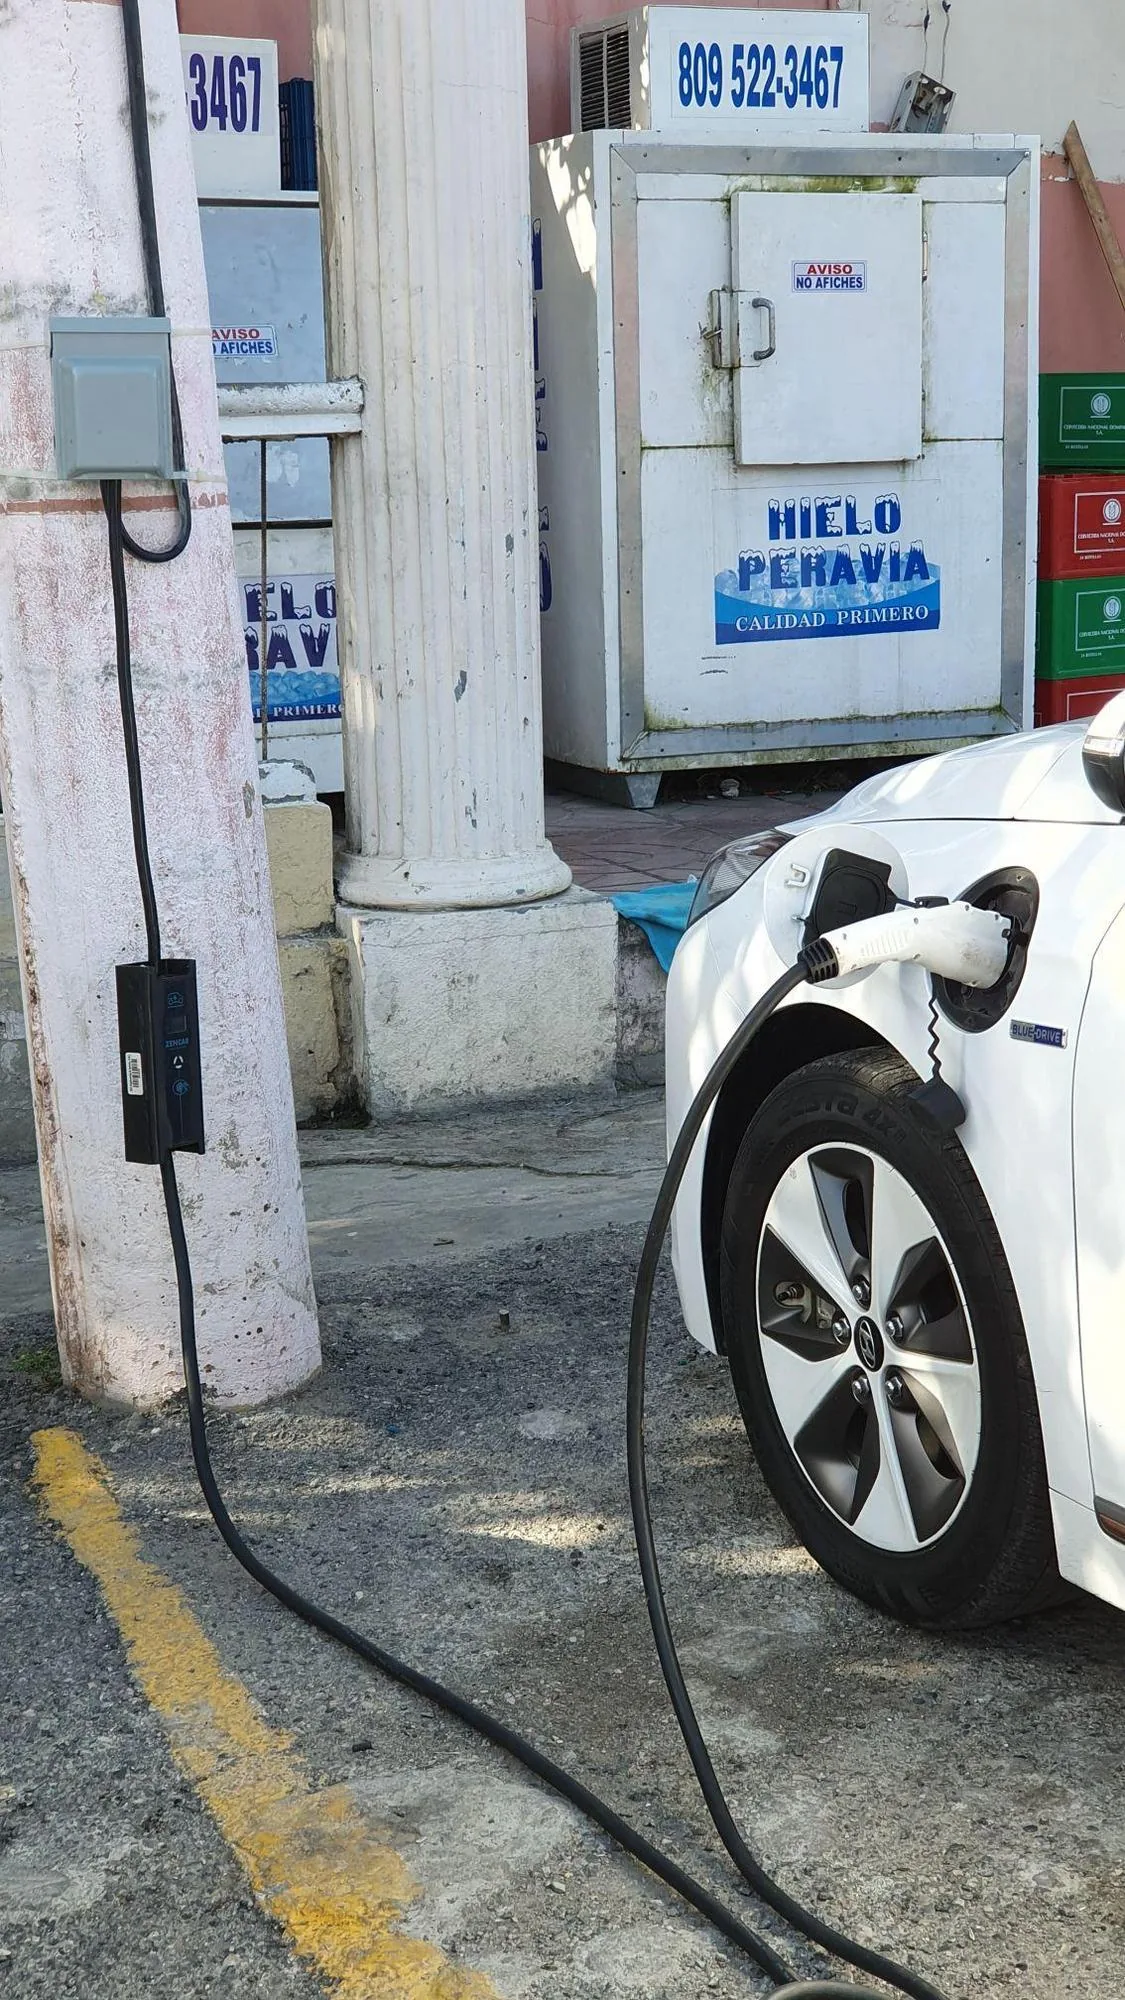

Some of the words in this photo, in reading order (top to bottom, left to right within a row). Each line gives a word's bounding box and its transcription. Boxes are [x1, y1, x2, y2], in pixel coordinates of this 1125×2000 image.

[679, 42, 723, 108] 809
[731, 43, 844, 109] 522-3467
[806, 263, 853, 276] AVISO
[795, 276, 813, 290] NO
[815, 276, 864, 290] AFICHES
[211, 328, 260, 340] AVISO
[221, 341, 273, 354] AFICHES
[767, 492, 902, 541] HIELO
[738, 539, 931, 592] PERAVIA
[735, 612, 826, 633] CALIDAD
[836, 604, 929, 626] PRIMERO
